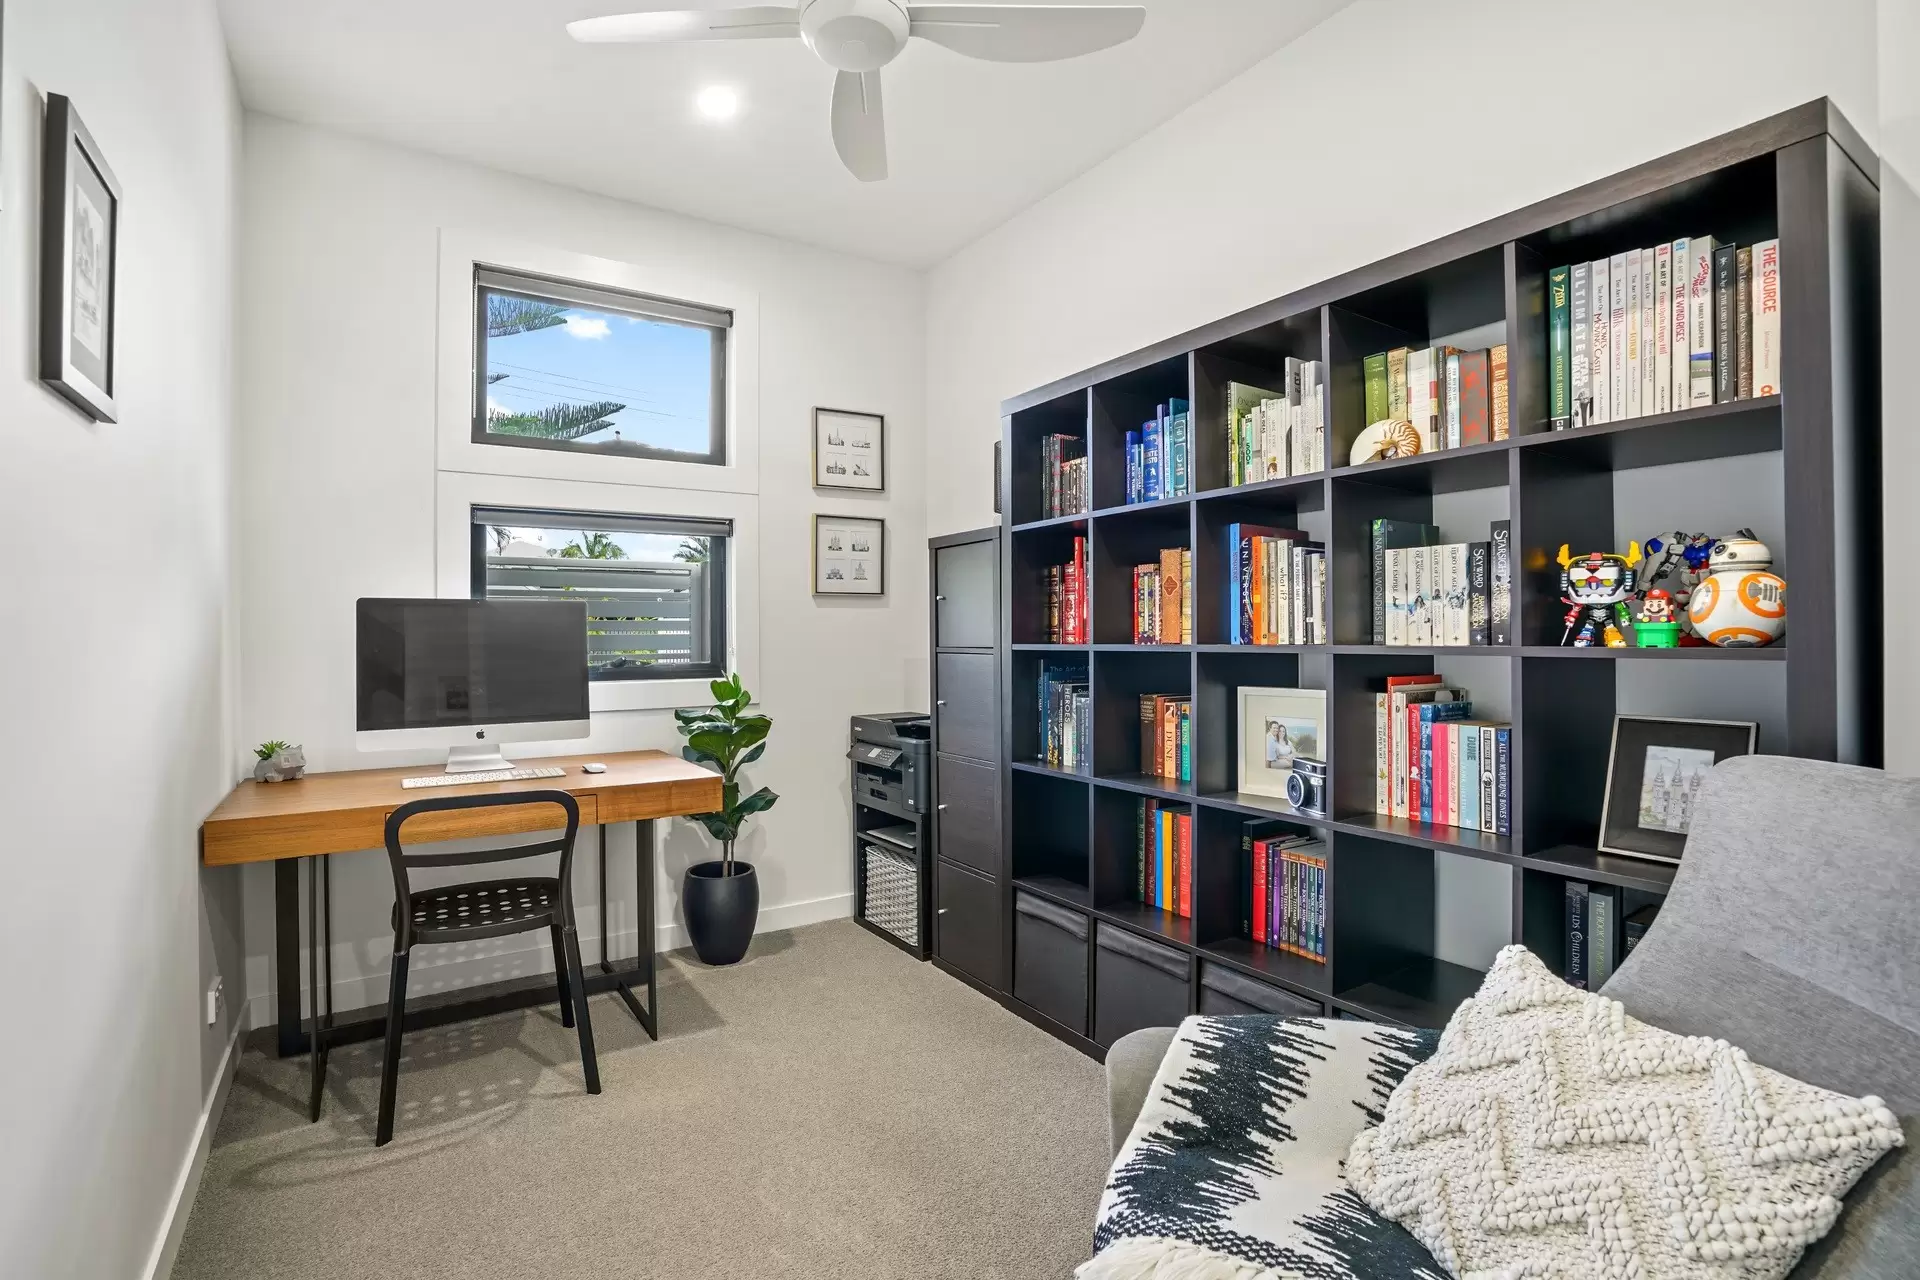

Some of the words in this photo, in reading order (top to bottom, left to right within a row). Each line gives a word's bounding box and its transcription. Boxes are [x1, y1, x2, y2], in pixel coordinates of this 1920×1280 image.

[1763, 245, 1776, 269] THE
[1676, 284, 1685, 299] THE
[1692, 277, 1700, 299] MUSIC
[1739, 274, 1747, 289] LORD
[1763, 271, 1776, 314] SOURCE
[1574, 268, 1588, 352] ULTIMATE
[1676, 301, 1685, 321] WIND
[1739, 313, 1747, 331] RINGS
[1593, 312, 1603, 348] MOVING
[1676, 321, 1685, 343] RISES
[1556, 355, 1564, 381] HYRULE
[1571, 354, 1581, 387] WARS
[1580, 355, 1590, 383] STAR
[1594, 349, 1602, 375] CASTLE
[1556, 383, 1564, 415] HISTORIA
[1374, 537, 1383, 576] NATURAL
[1494, 530, 1508, 577] STARSIGHT
[1279, 567, 1287, 587] what
[1473, 548, 1485, 588] SKYWARD
[1374, 577, 1383, 621] WONDERS
[1493, 581, 1501, 624] SANDERSON
[1500, 584, 1508, 620] BRANDON
[1165, 731, 1173, 762] DUNE
[1181, 723, 1189, 746] DUNE
[1499, 742, 1507, 753] ALL
[1467, 736, 1477, 761] DUNE
[1498, 763, 1506, 797] MURMURING
[1499, 798, 1507, 818] BONES
[1596, 901, 1605, 915] THE
[1572, 914, 1580, 929] LDS
[1596, 916, 1605, 937] BOOK
[1571, 931, 1583, 975] CHILDREN
